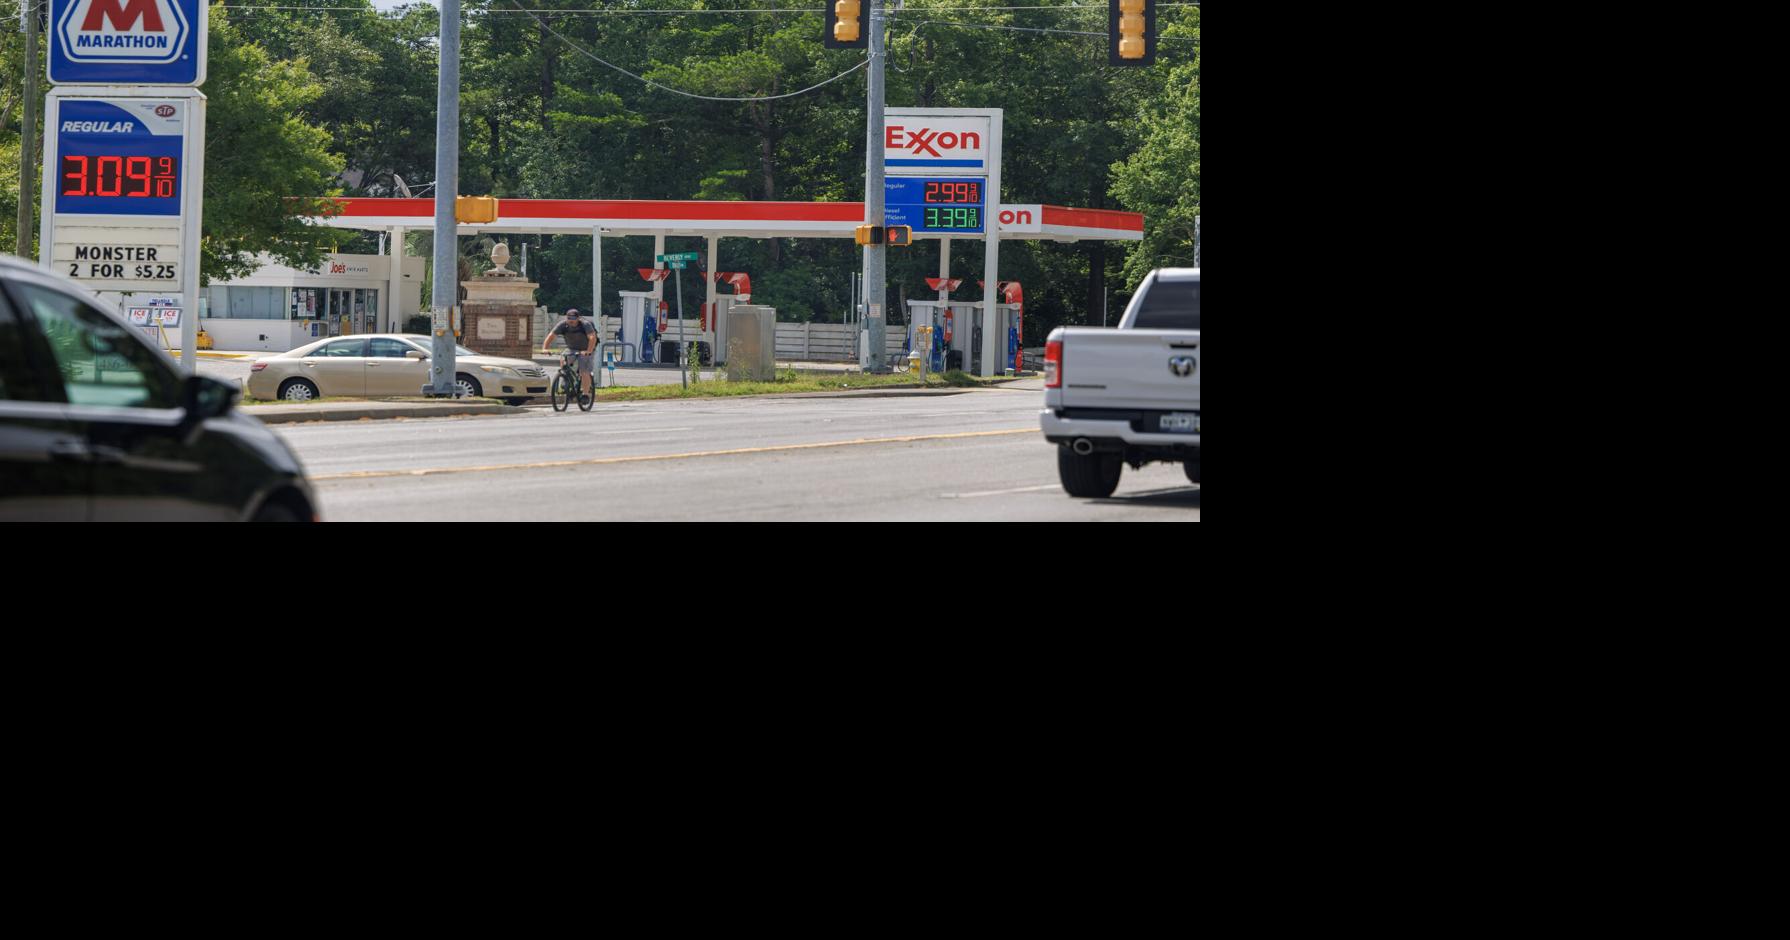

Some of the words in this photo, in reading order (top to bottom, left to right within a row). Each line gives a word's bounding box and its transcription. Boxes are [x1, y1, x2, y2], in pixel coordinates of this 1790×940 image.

[77, 35, 167, 48] MARATHON
[61, 121, 134, 133] REGULAR
[885, 126, 980, 157] Exxon
[63, 155, 151, 197] 3.09
[926, 183, 968, 203] 2.99
[926, 208, 968, 228] 3.39
[75, 246, 157, 261] MONSTER
[69, 263, 79, 277] 2
[91, 264, 124, 277] FOR
[135, 265, 175, 279] $5.25
